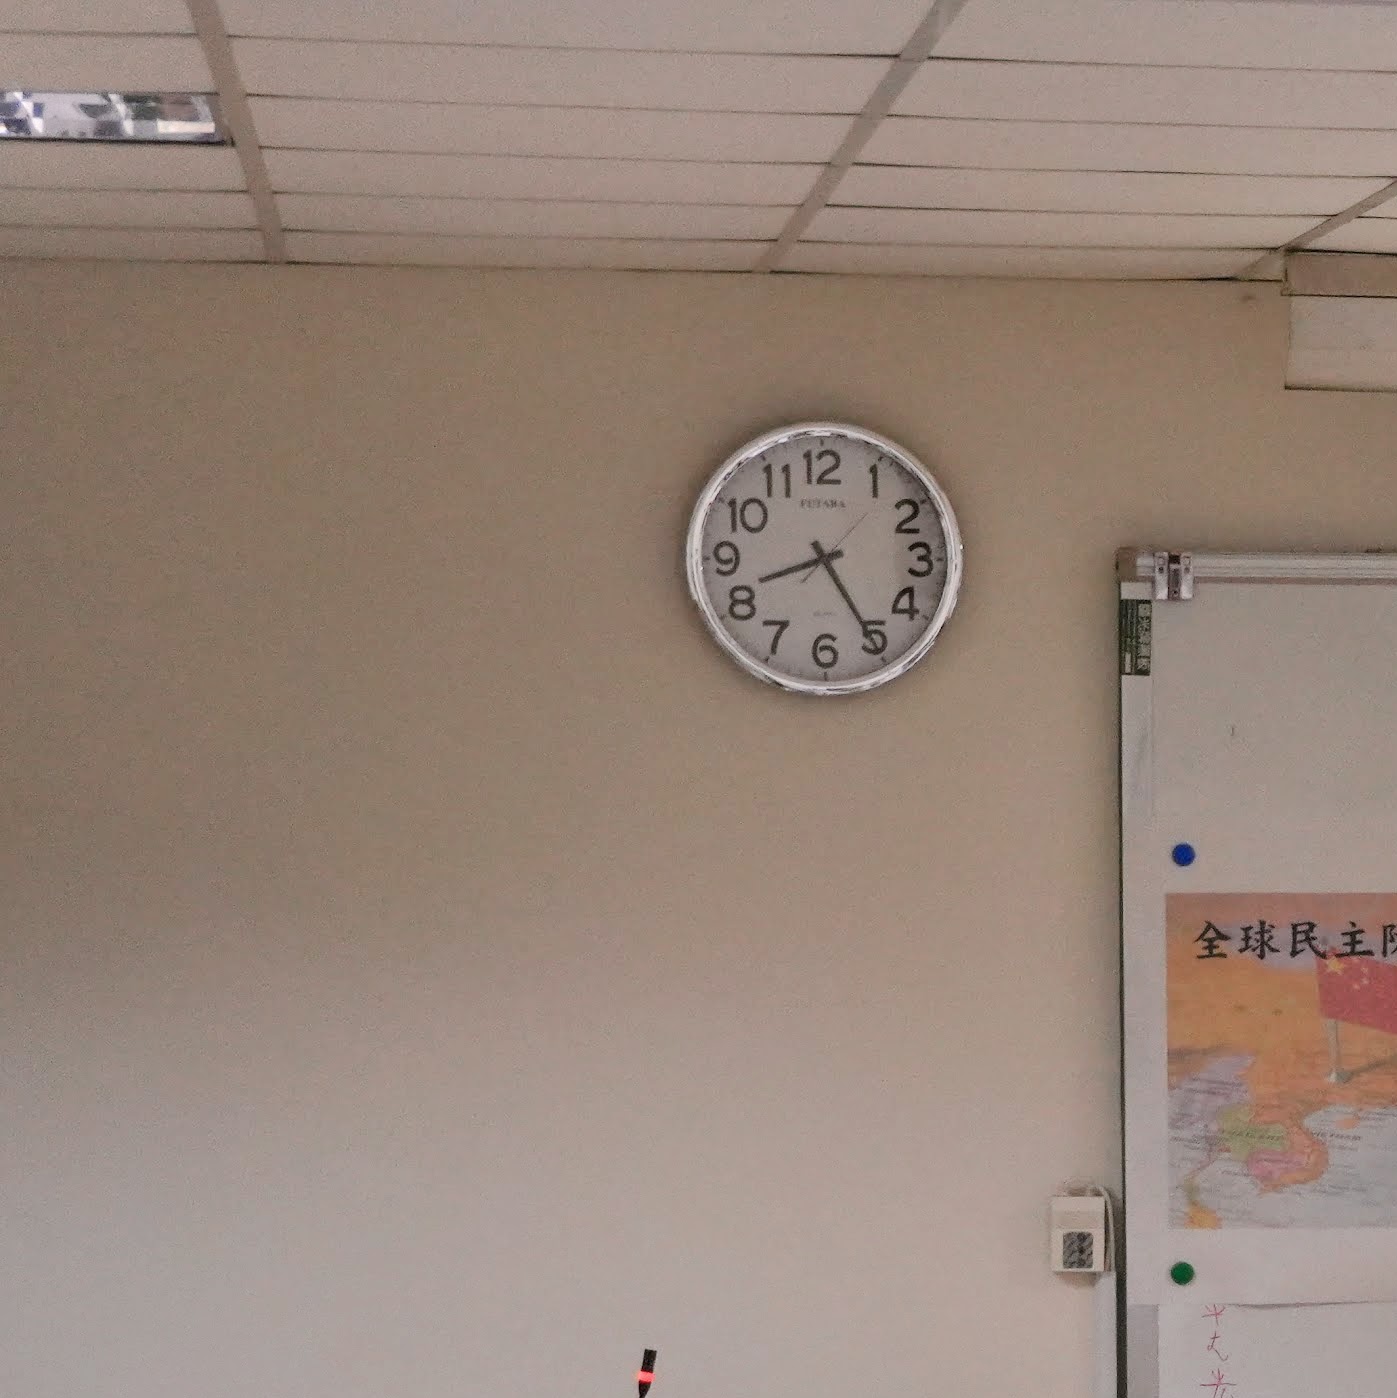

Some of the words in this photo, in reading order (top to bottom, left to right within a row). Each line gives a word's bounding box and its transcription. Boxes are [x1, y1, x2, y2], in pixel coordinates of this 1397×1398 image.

[763, 463, 791, 498] 11
[803, 449, 842, 485] 12
[869, 463, 879, 498] 1
[728, 497, 769, 533] 10
[895, 498, 921, 534] 2
[712, 540, 741, 576] 9
[907, 541, 934, 577] 3
[728, 584, 757, 621] 8
[891, 585, 920, 621] 4
[762, 620, 790, 655] 7
[811, 633, 839, 669] 6
[861, 620, 888, 655] 5
